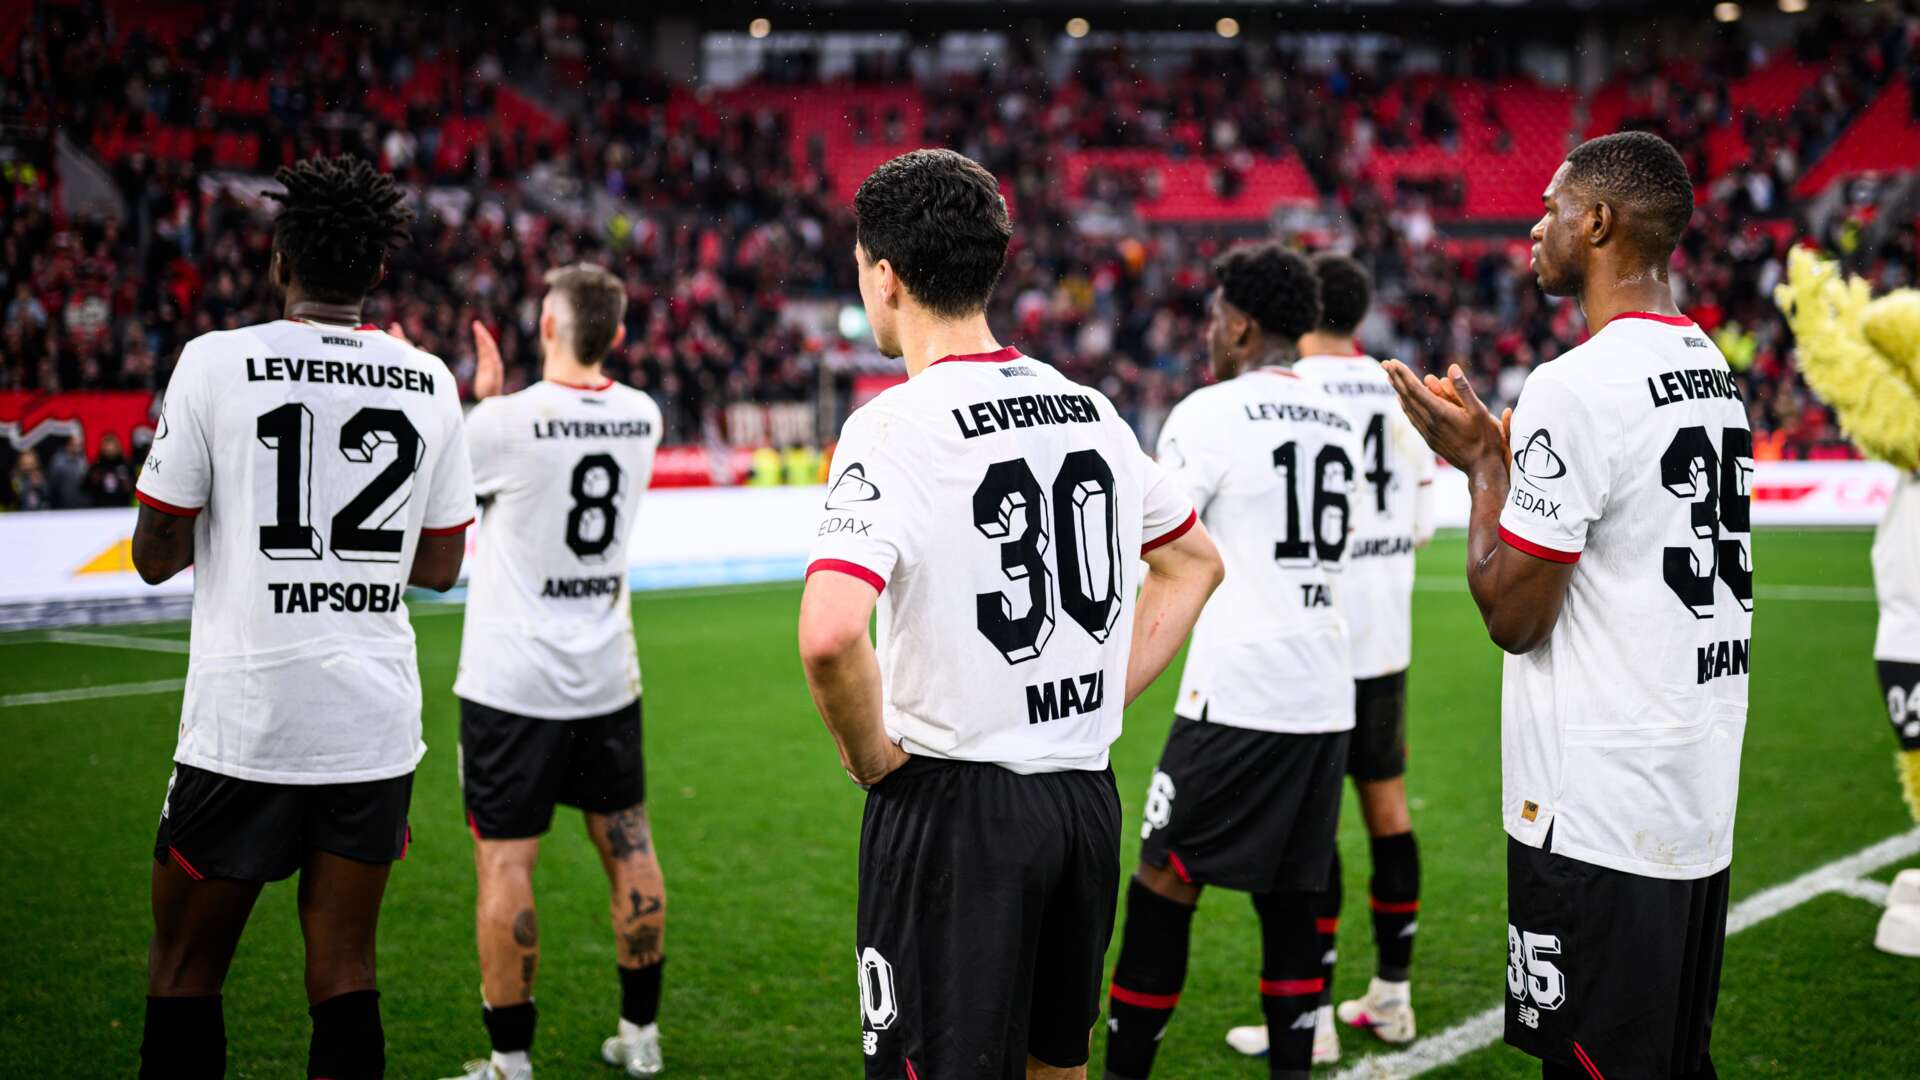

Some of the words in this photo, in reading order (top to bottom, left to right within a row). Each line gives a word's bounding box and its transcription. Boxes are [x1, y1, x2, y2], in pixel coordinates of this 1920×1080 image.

[246, 358, 435, 395] LEVERKUSEN
[951, 394, 1101, 439] LEVERKUSEN
[257, 403, 426, 562] 12
[565, 452, 628, 565] 8
[1272, 441, 1355, 571] 16
[1363, 413, 1398, 516] 4
[972, 449, 1123, 665] 30
[1660, 426, 1753, 619] 35
[1301, 584, 1332, 608] TA
[1147, 768, 1177, 830] 6
[856, 947, 898, 1030] 0
[1508, 922, 1566, 1010] 35
